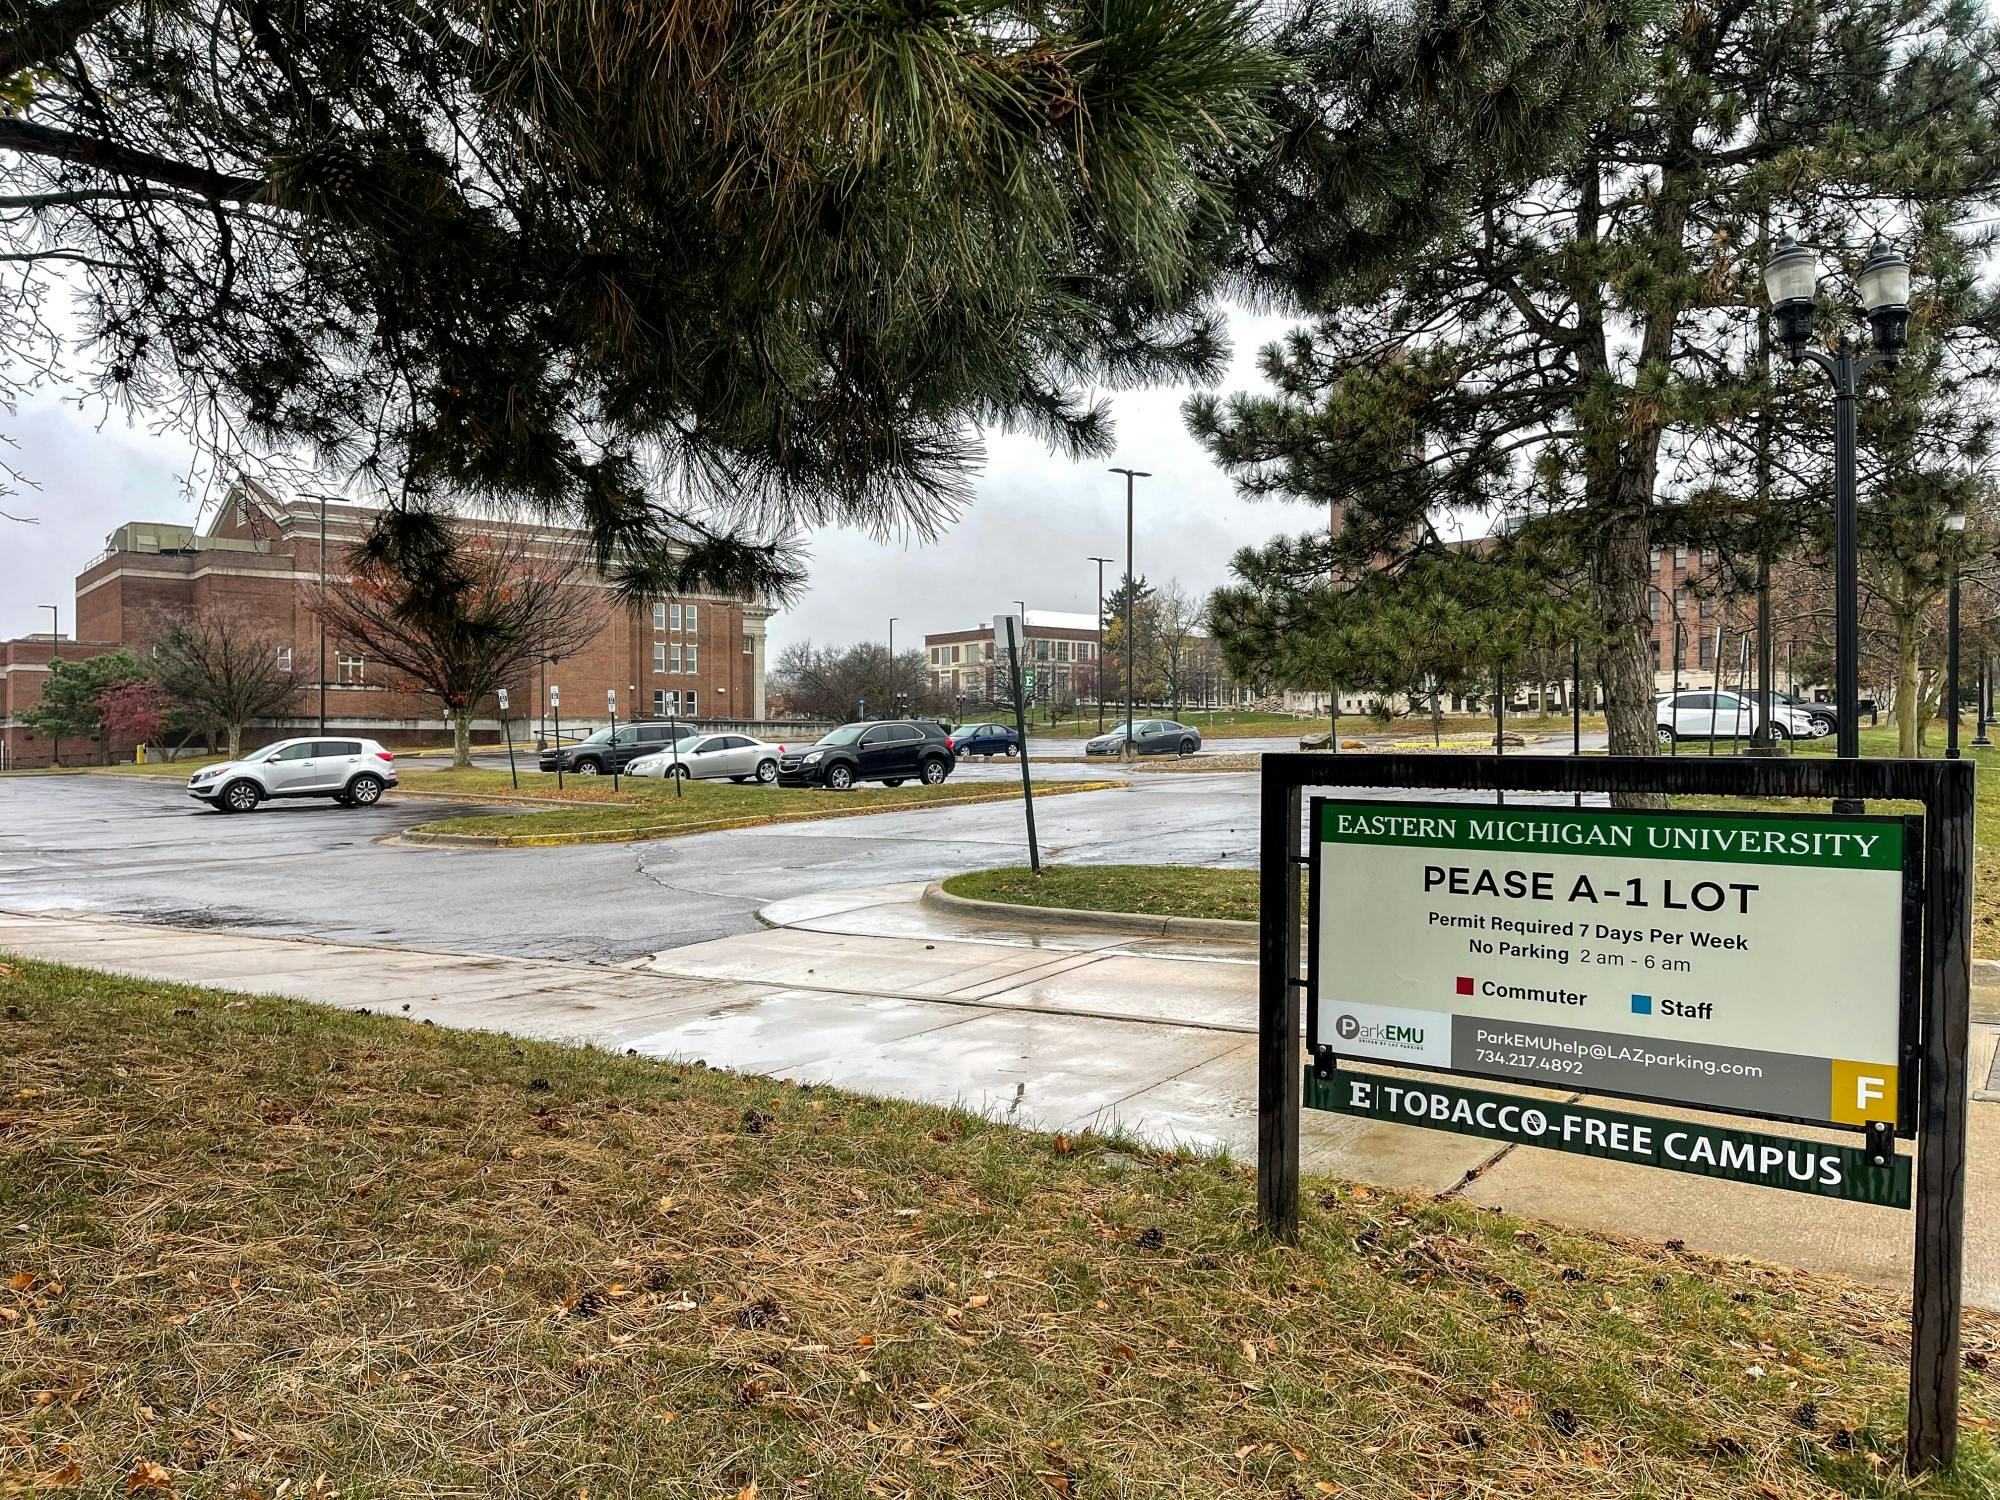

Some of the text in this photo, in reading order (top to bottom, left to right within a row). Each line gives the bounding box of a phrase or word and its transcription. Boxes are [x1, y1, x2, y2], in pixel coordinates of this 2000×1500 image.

[1025, 675, 1033, 686] E
[1337, 814, 1880, 858] EASTERN MICHIGAN UNIVERSITY
[1424, 865, 1760, 914] PEASE A-1 LOT
[1428, 911, 1749, 951] Permit Required 7 Days Per Week
[1469, 939, 1493, 954] No
[1499, 941, 1569, 965] Parking
[1580, 949, 1591, 963] 2
[1596, 952, 1624, 966] am
[1644, 955, 1655, 969] 6
[1661, 958, 1691, 972] am
[1481, 981, 1588, 1006] Commuter
[1660, 999, 1713, 1020] Staff
[1476, 1049, 1583, 1075] 734.217.4892
[1477, 1030, 1763, 1077] ParkEMUhelp@LAZparking.com
[1856, 1076, 1885, 1109] F
[1349, 1081, 1842, 1185] E TOBACCO-FREE CAMPUS
